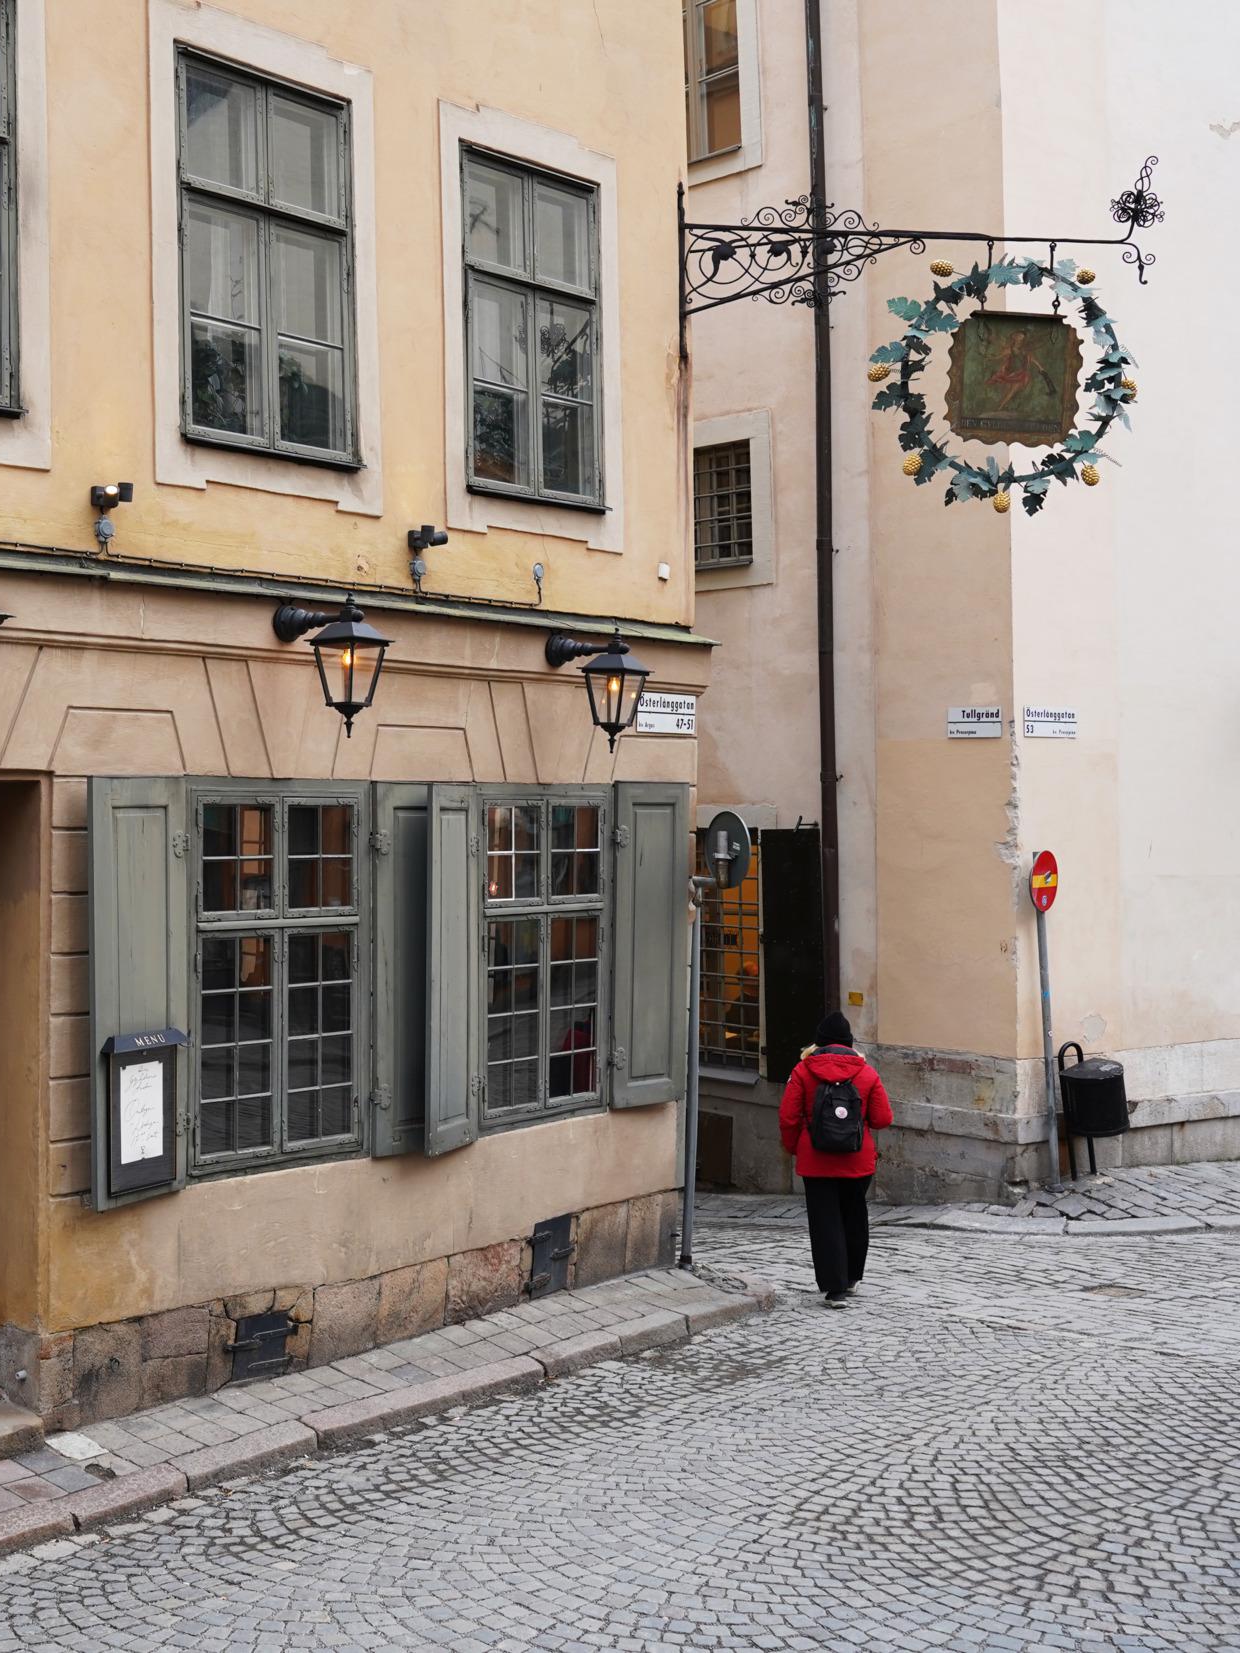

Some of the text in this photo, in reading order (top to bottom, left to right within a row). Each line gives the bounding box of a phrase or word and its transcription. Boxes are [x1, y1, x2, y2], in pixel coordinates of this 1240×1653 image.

[640, 693, 694, 712] Österlånggatan
[962, 708, 1000, 721] Tullgränd
[1026, 706, 1076, 721] Österlånggatan
[676, 718, 694, 730] 47-51
[1026, 724, 1034, 734] 53
[135, 1034, 166, 1046] MENU
